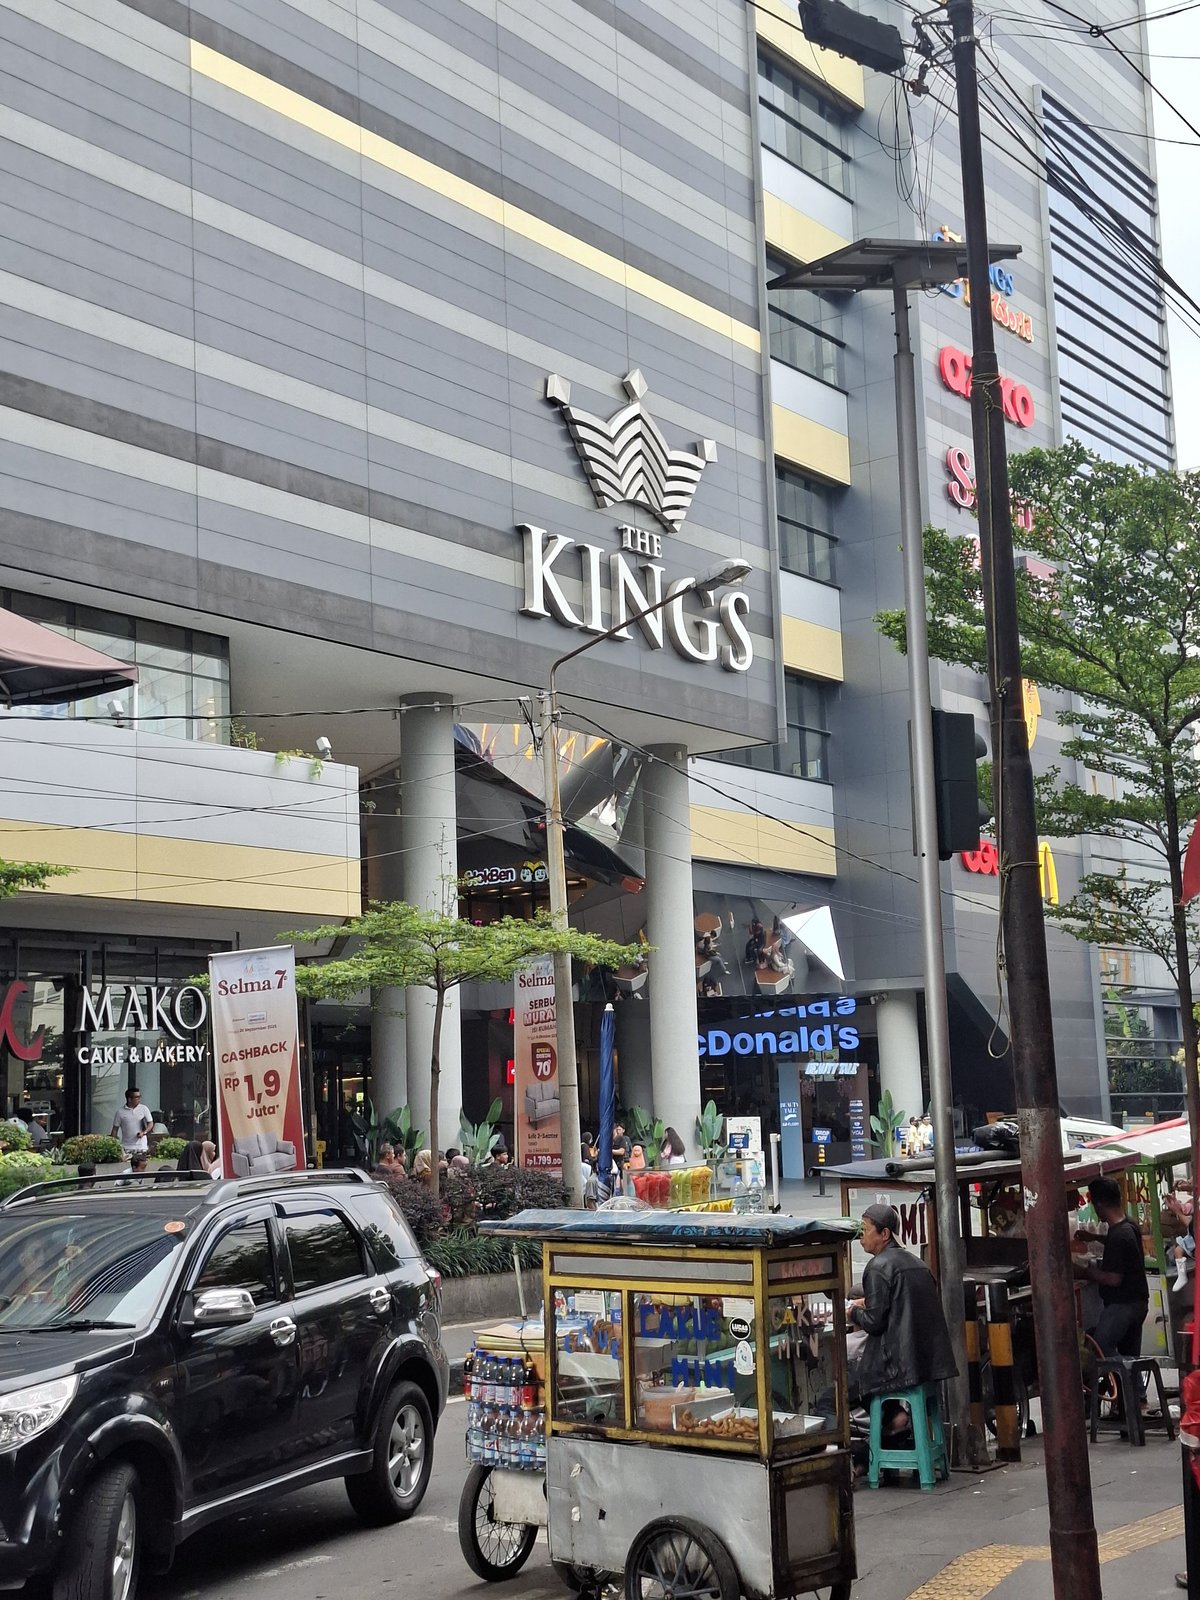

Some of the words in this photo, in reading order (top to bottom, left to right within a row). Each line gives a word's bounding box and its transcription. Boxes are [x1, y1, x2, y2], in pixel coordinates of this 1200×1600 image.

[618, 524, 663, 558] THE
[515, 523, 753, 672] KINGS
[218, 977, 271, 996] Selma
[519, 974, 555, 988] Selma
[77, 985, 207, 1041] MAKO
[529, 997, 555, 1010] SERBU
[523, 1009, 556, 1027] MURA
[78, 1046, 124, 1064] CAKE
[129, 1046, 140, 1063] &
[144, 1044, 206, 1063] BAKERY
[221, 1041, 287, 1064] CASHBACK
[224, 1078, 240, 1092] Rp
[243, 1069, 281, 1104] 1,9
[639, 1304, 721, 1342] CAKUE
